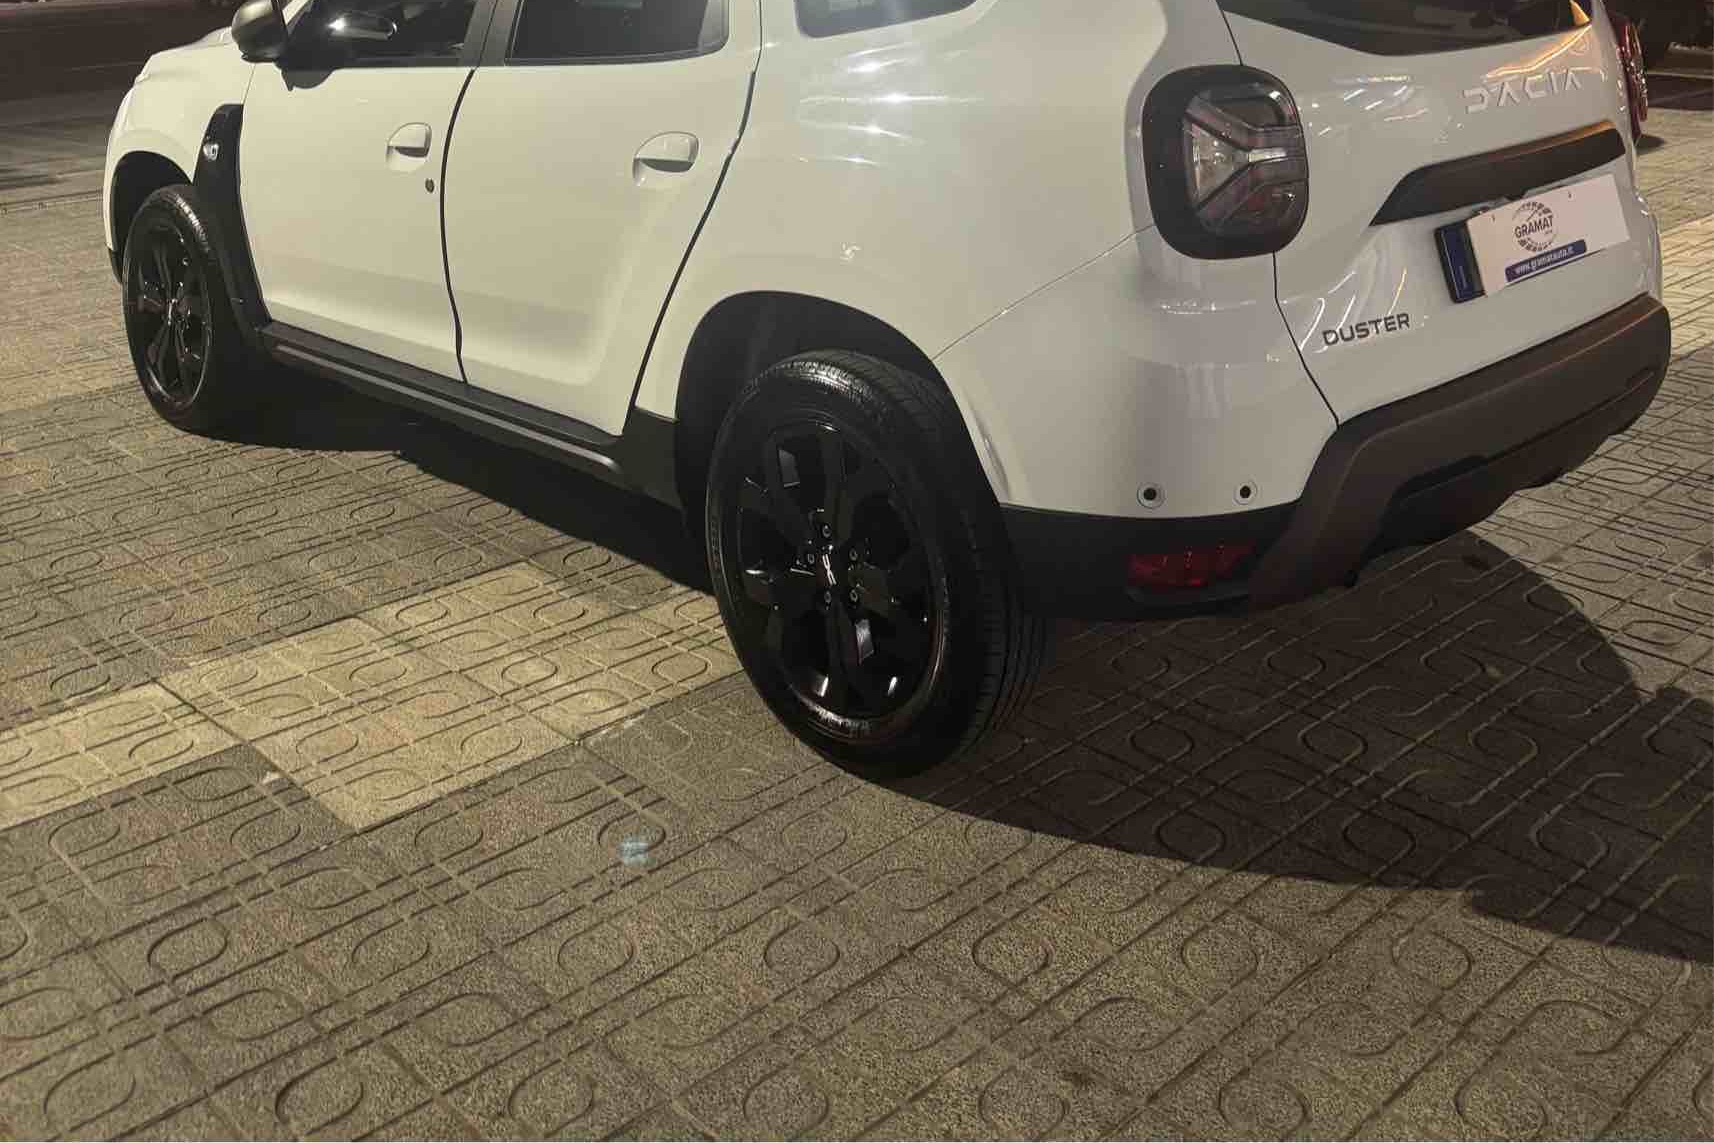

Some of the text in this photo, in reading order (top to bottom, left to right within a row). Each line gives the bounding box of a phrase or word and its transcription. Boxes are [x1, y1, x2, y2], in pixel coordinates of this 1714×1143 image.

[1462, 66, 1584, 115] DACIA
[1513, 215, 1554, 239] GRAMAT
[1322, 312, 1410, 346] DUSTER
